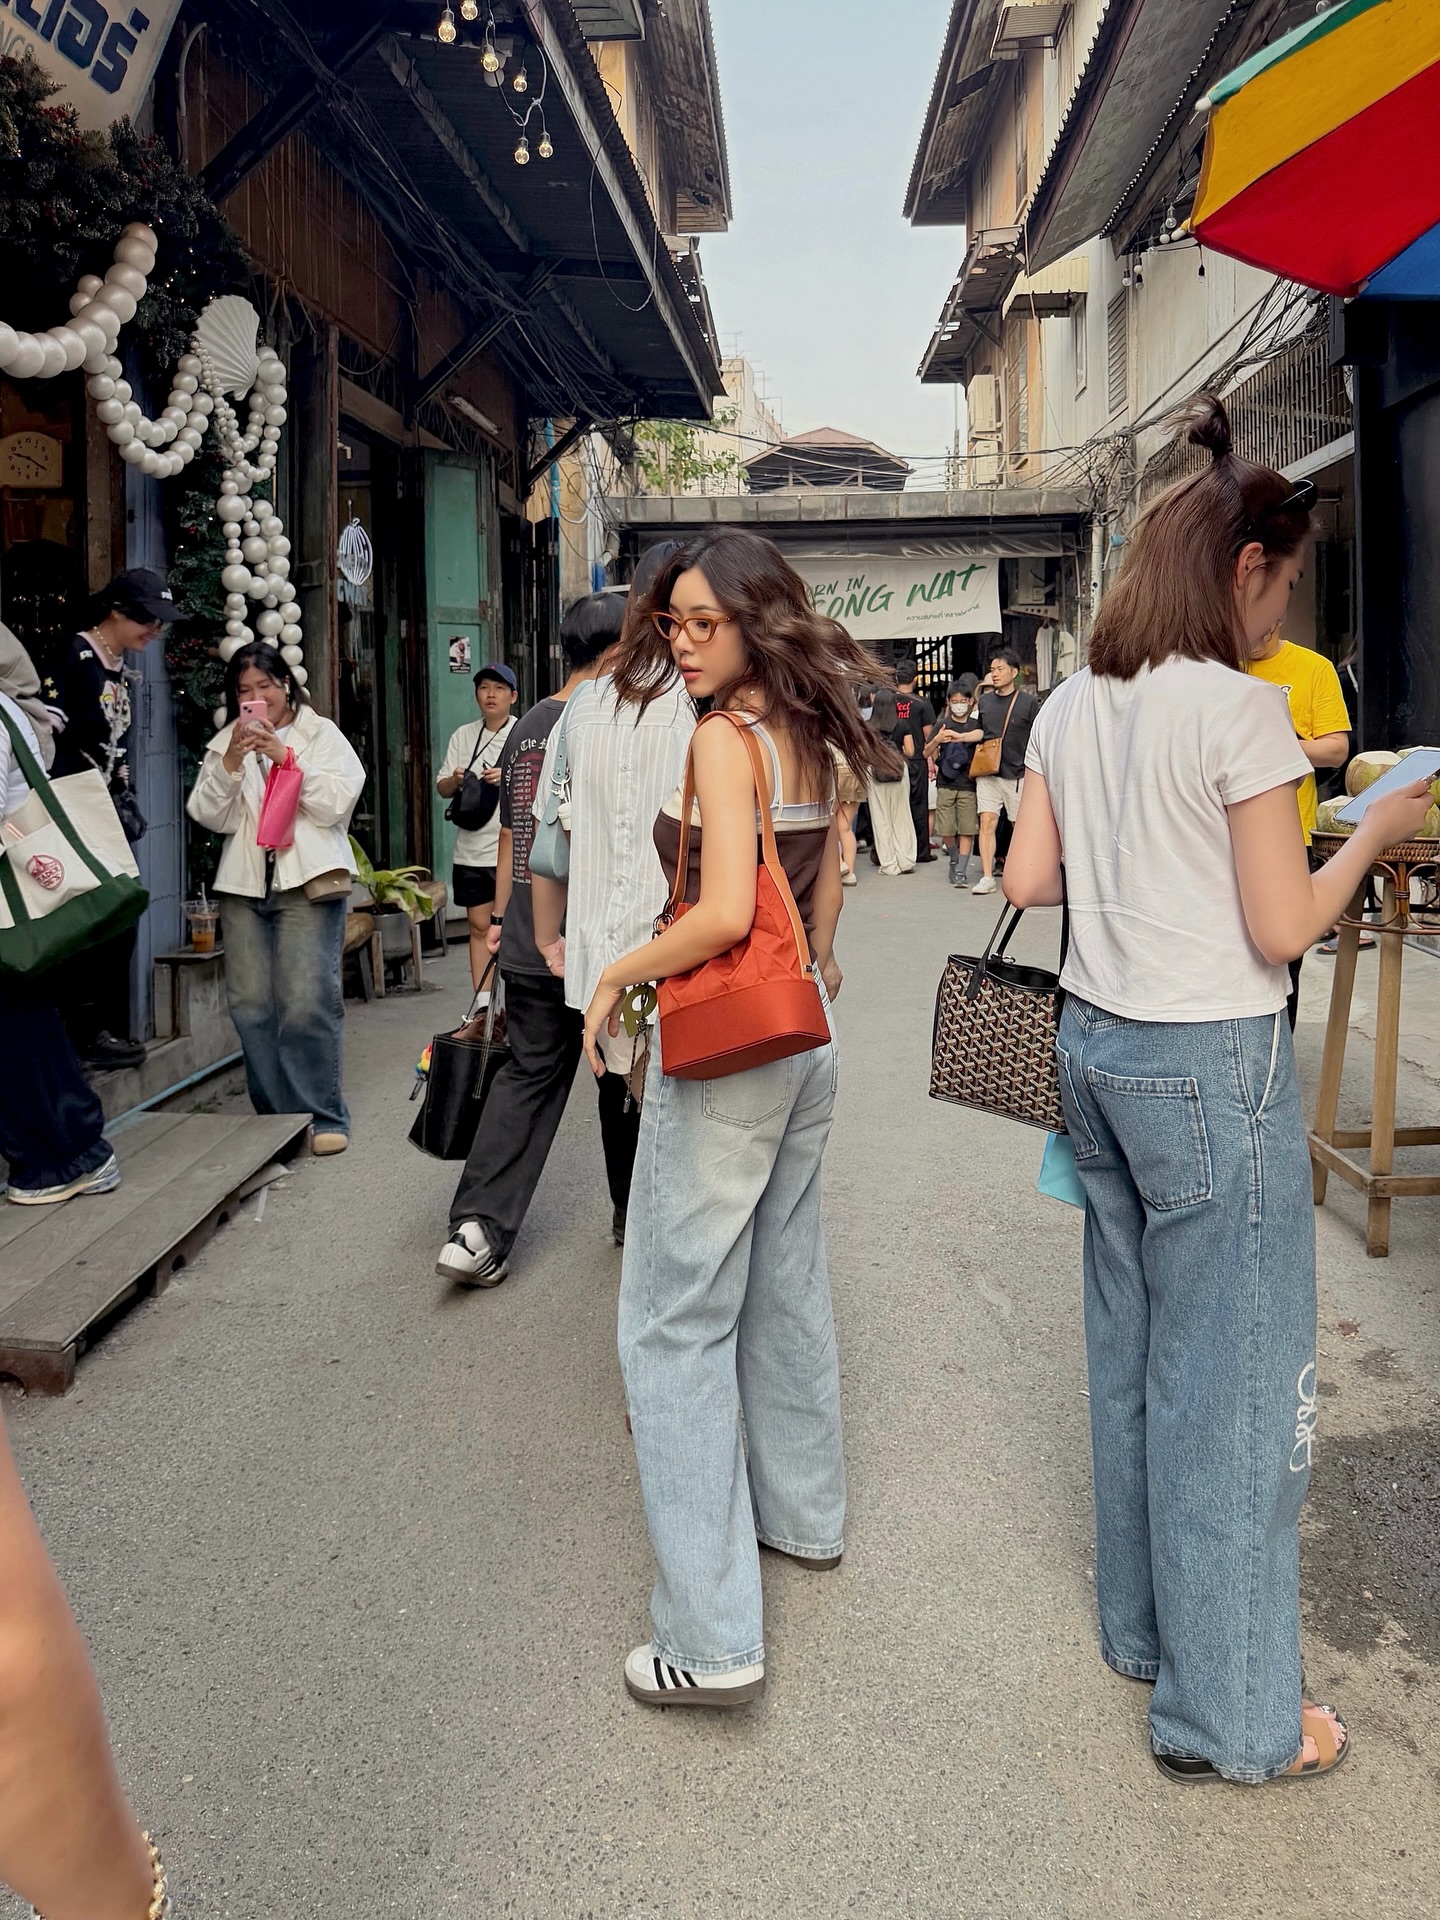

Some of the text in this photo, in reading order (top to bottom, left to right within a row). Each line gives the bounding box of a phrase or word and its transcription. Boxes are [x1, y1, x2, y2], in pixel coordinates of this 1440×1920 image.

[811, 574, 866, 597] RN IN
[905, 562, 988, 608] WAT
